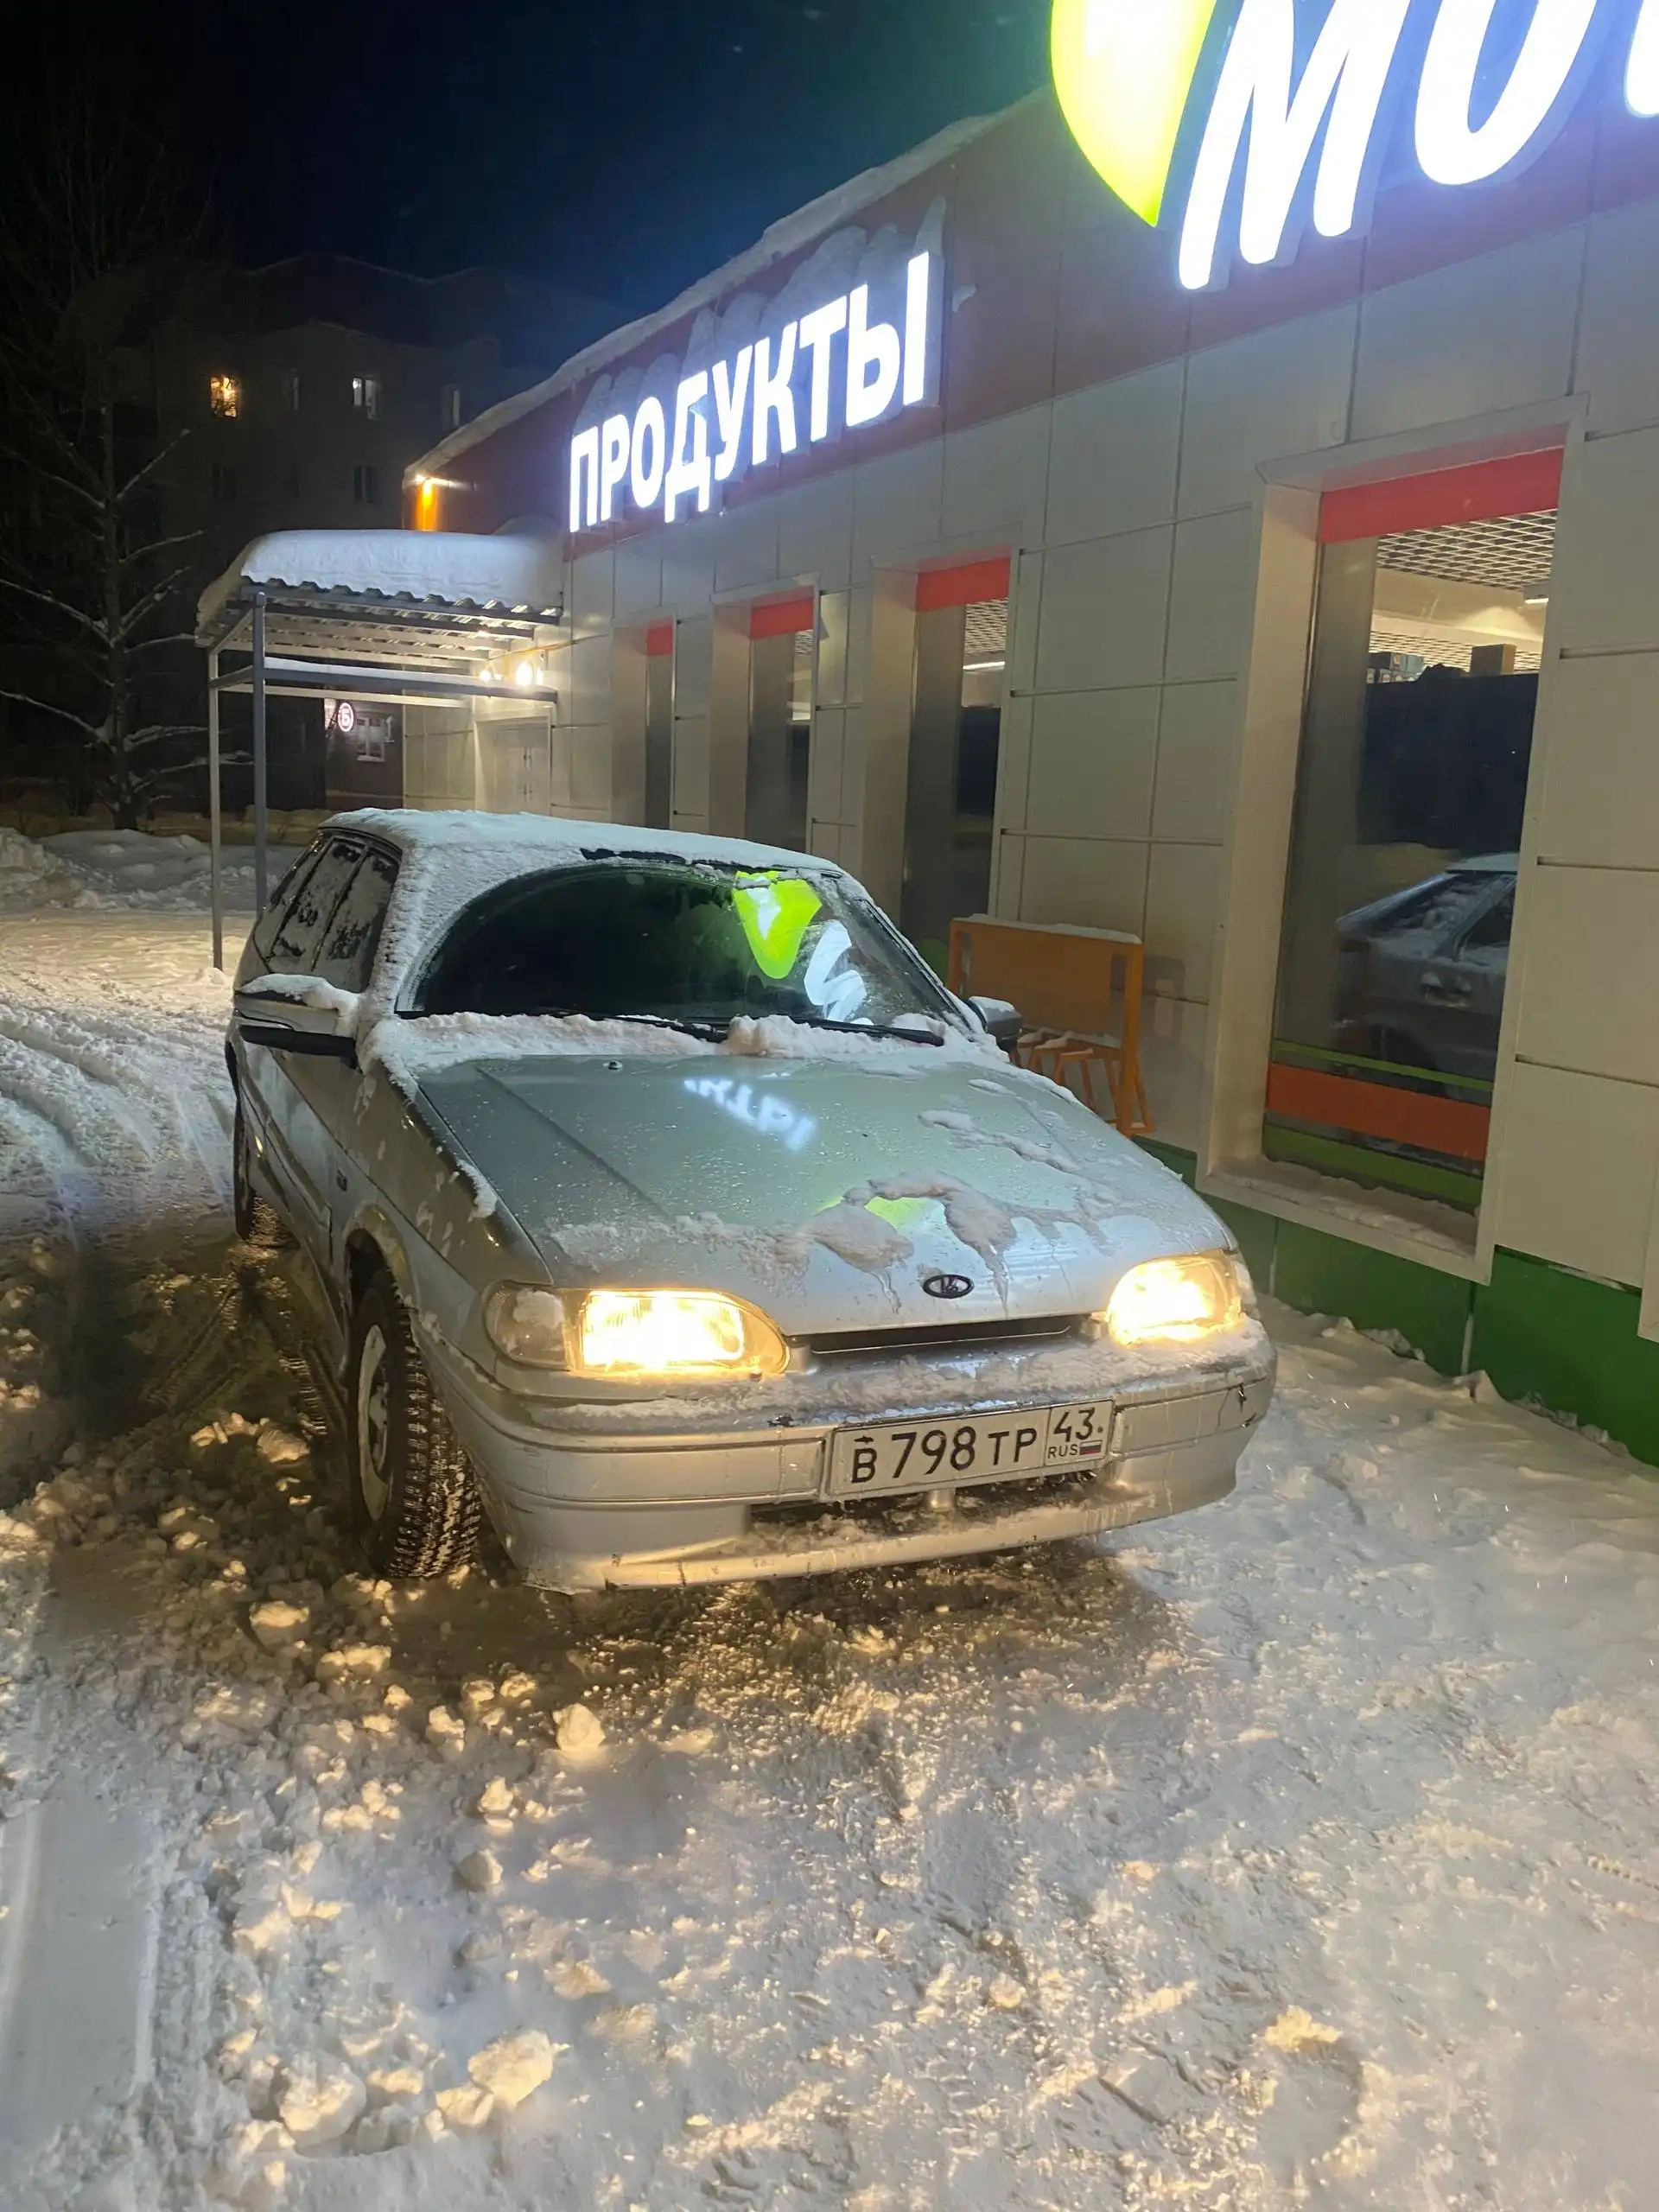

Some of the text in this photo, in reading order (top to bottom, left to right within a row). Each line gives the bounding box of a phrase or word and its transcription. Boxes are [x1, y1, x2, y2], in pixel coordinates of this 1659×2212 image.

[569, 251, 930, 533] ПРОДУКТЫ
[1053, 1407, 1095, 1444] 43
[1047, 1444, 1079, 1459] RUS
